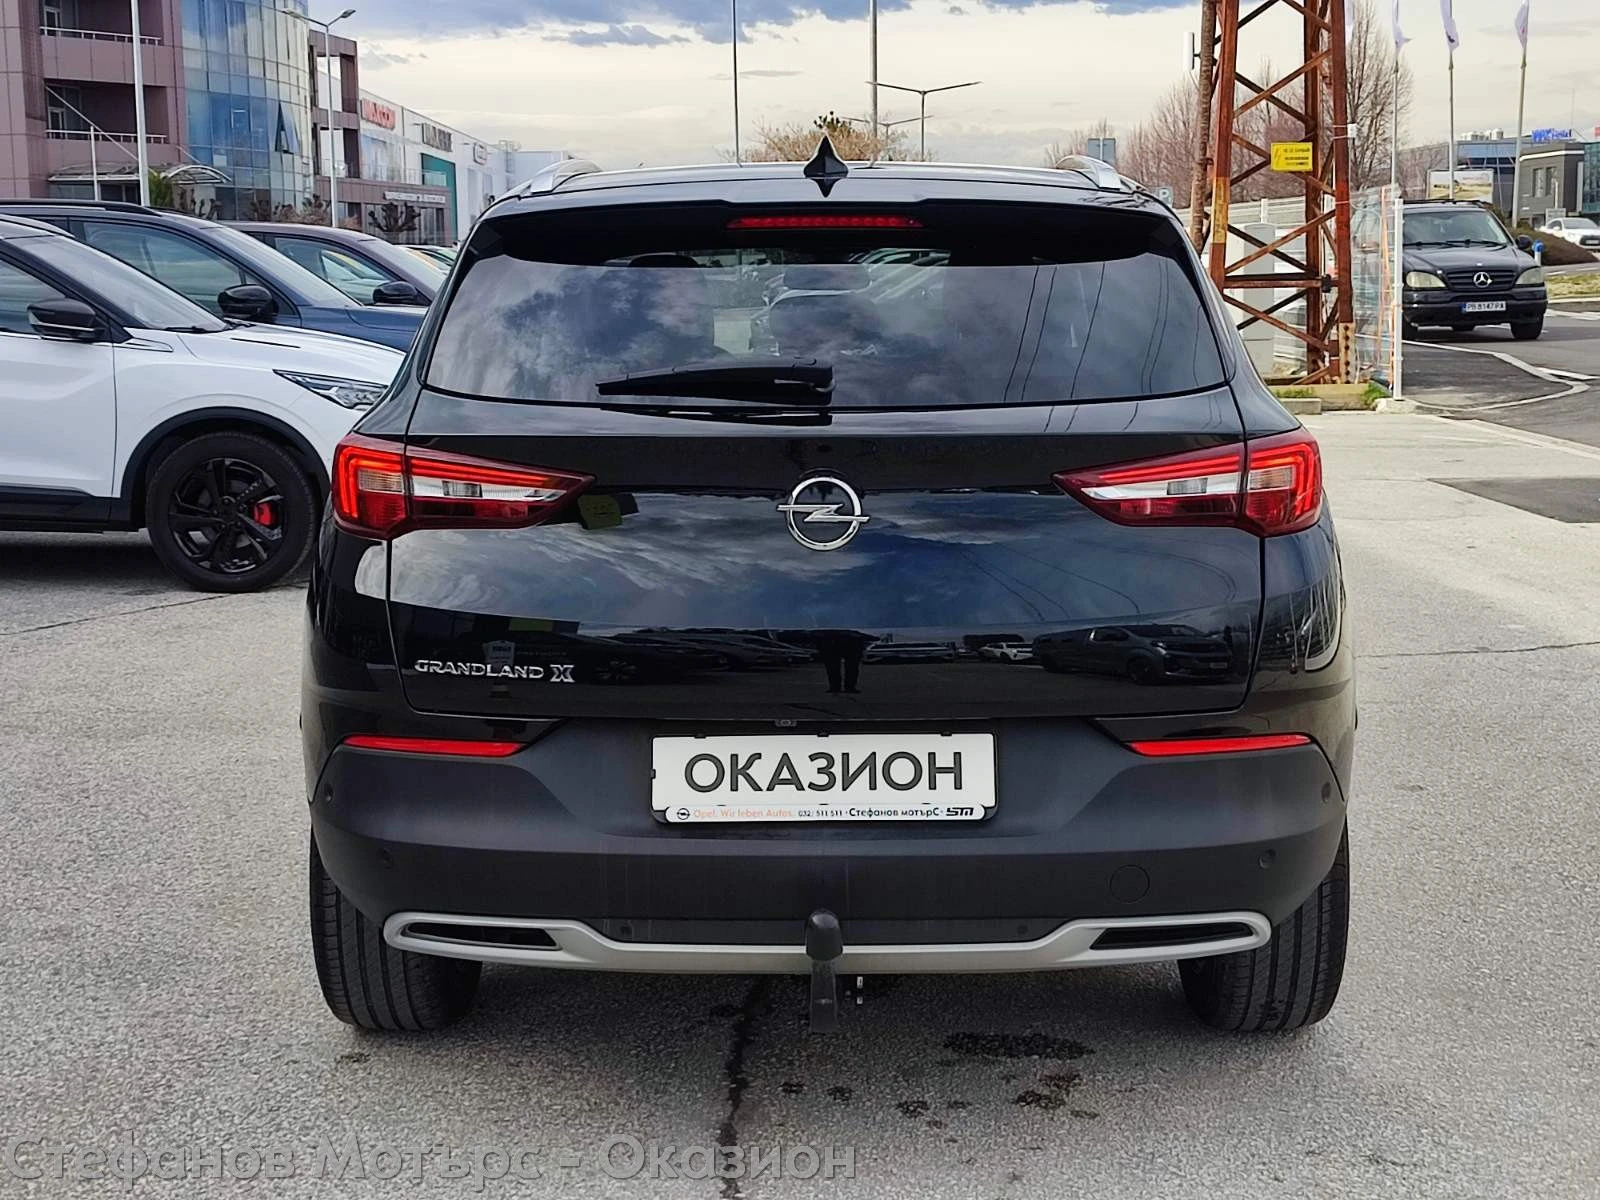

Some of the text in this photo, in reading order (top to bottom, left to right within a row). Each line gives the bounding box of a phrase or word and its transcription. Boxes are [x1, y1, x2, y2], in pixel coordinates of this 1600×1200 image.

[414, 659, 575, 683] GRANDLAND X
[684, 751, 963, 793] ОКАЗИОН
